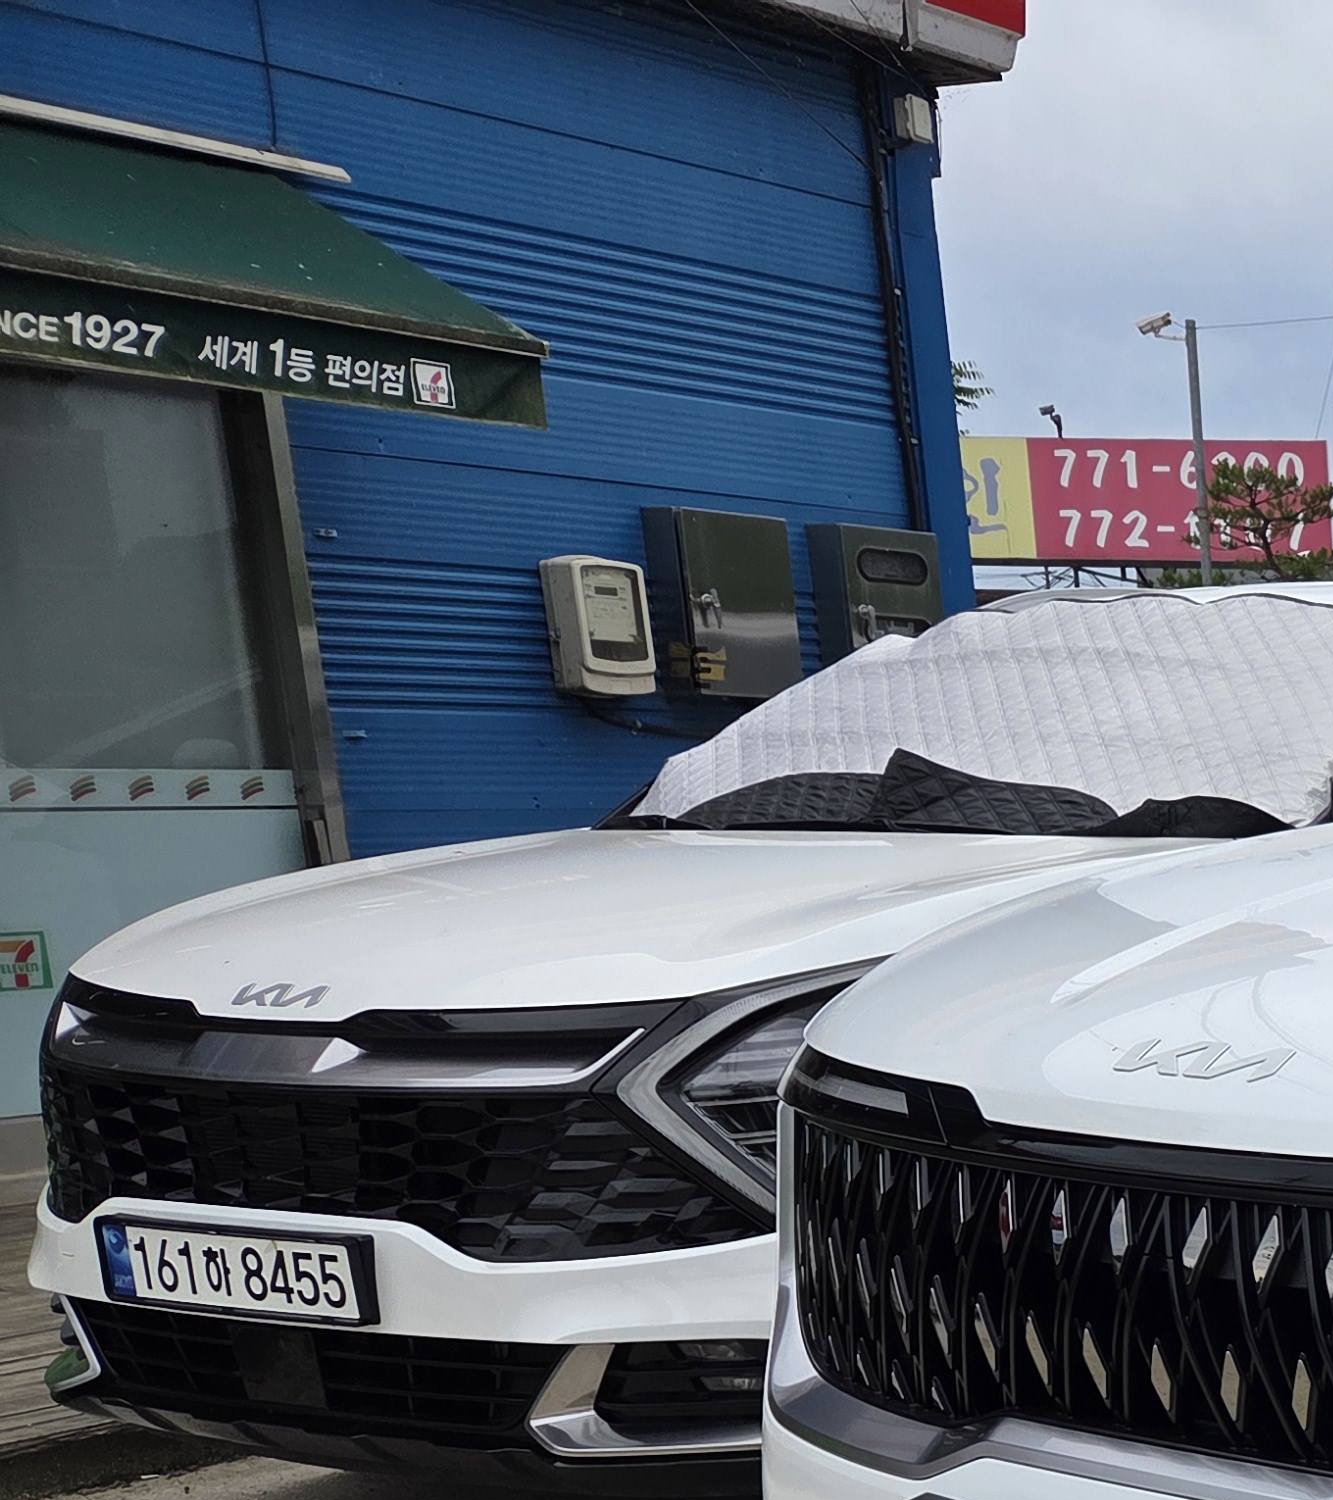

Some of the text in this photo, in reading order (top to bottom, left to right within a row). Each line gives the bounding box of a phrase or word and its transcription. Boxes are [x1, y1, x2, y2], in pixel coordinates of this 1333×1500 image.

[64, 311, 166, 358] 1927
[198, 335, 406, 396] 세계 1등 편의점
[230, 982, 332, 1009] KIA
[1112, 1038, 1298, 1084] KIA
[133, 1236, 347, 1309] 161하 8455
